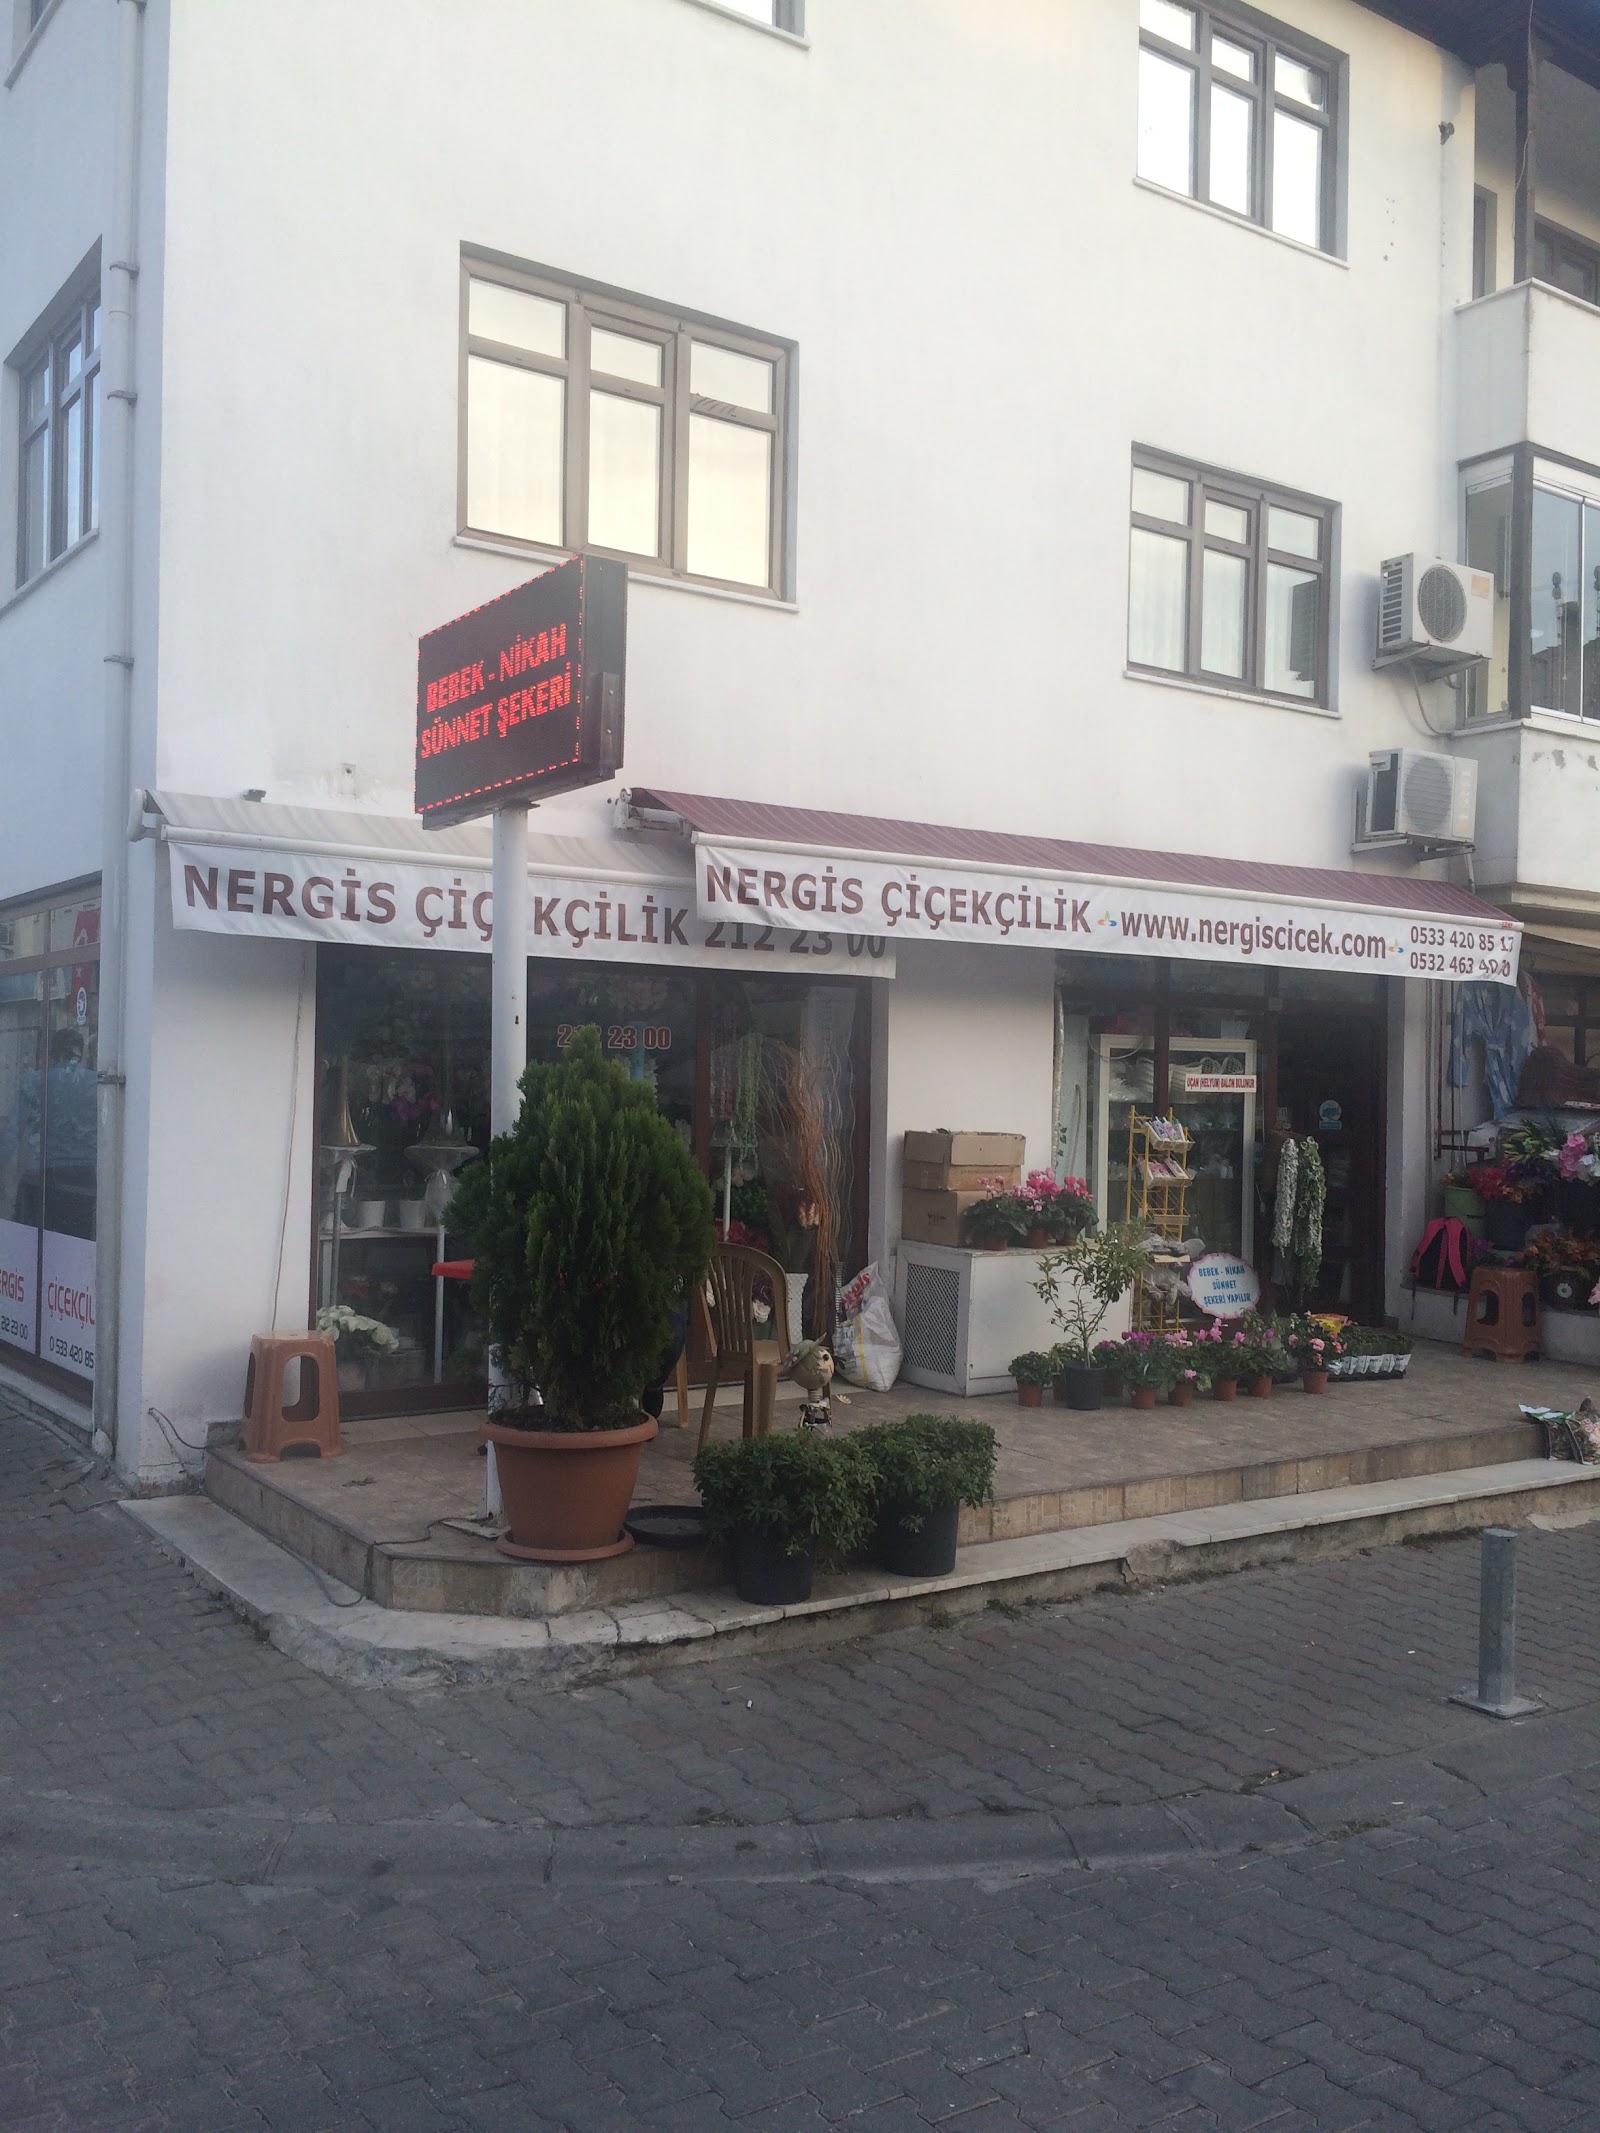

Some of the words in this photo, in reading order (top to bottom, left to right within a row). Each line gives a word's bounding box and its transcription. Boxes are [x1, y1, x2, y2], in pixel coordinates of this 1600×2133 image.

[426, 660, 484, 713] BEBEK
[500, 622, 567, 682] NİKAH
[420, 702, 493, 759] SÜNNET
[497, 661, 571, 738] ŞEKERİ
[184, 865, 396, 924] NERGİS
[415, 878, 690, 948] ÇİÇKÇİLİK
[706, 864, 864, 915] NERGİS
[880, 874, 1092, 935] ÇİÇEKÇİLİK
[1120, 911, 1387, 960] www.nergiscicek.com
[1410, 926, 1445, 946] 0533
[1449, 930, 1475, 950] 420
[1479, 934, 1495, 952] 85
[1410, 951, 1445, 972] 0532
[1449, 956, 1474, 974] 463
[608, 1025, 637, 1050] 23
[643, 1026, 672, 1050] 00
[1221, 1078, 1235, 1089] BALON
[1198, 1266, 1220, 1278] BEBEK
[1225, 1264, 1245, 1276] NİKAH
[1212, 1278, 1237, 1291] SÜNNET
[1203, 1292, 1226, 1307] ŞEKERİ
[1226, 1293, 1252, 1304] YAPILIR
[11, 1319, 19, 1336] 23
[20, 1322, 29, 1340] 00
[50, 1335, 55, 1352] 0
[56, 1338, 68, 1358] 533
[69, 1343, 83, 1365] 420
[84, 1350, 95, 1370] 85
